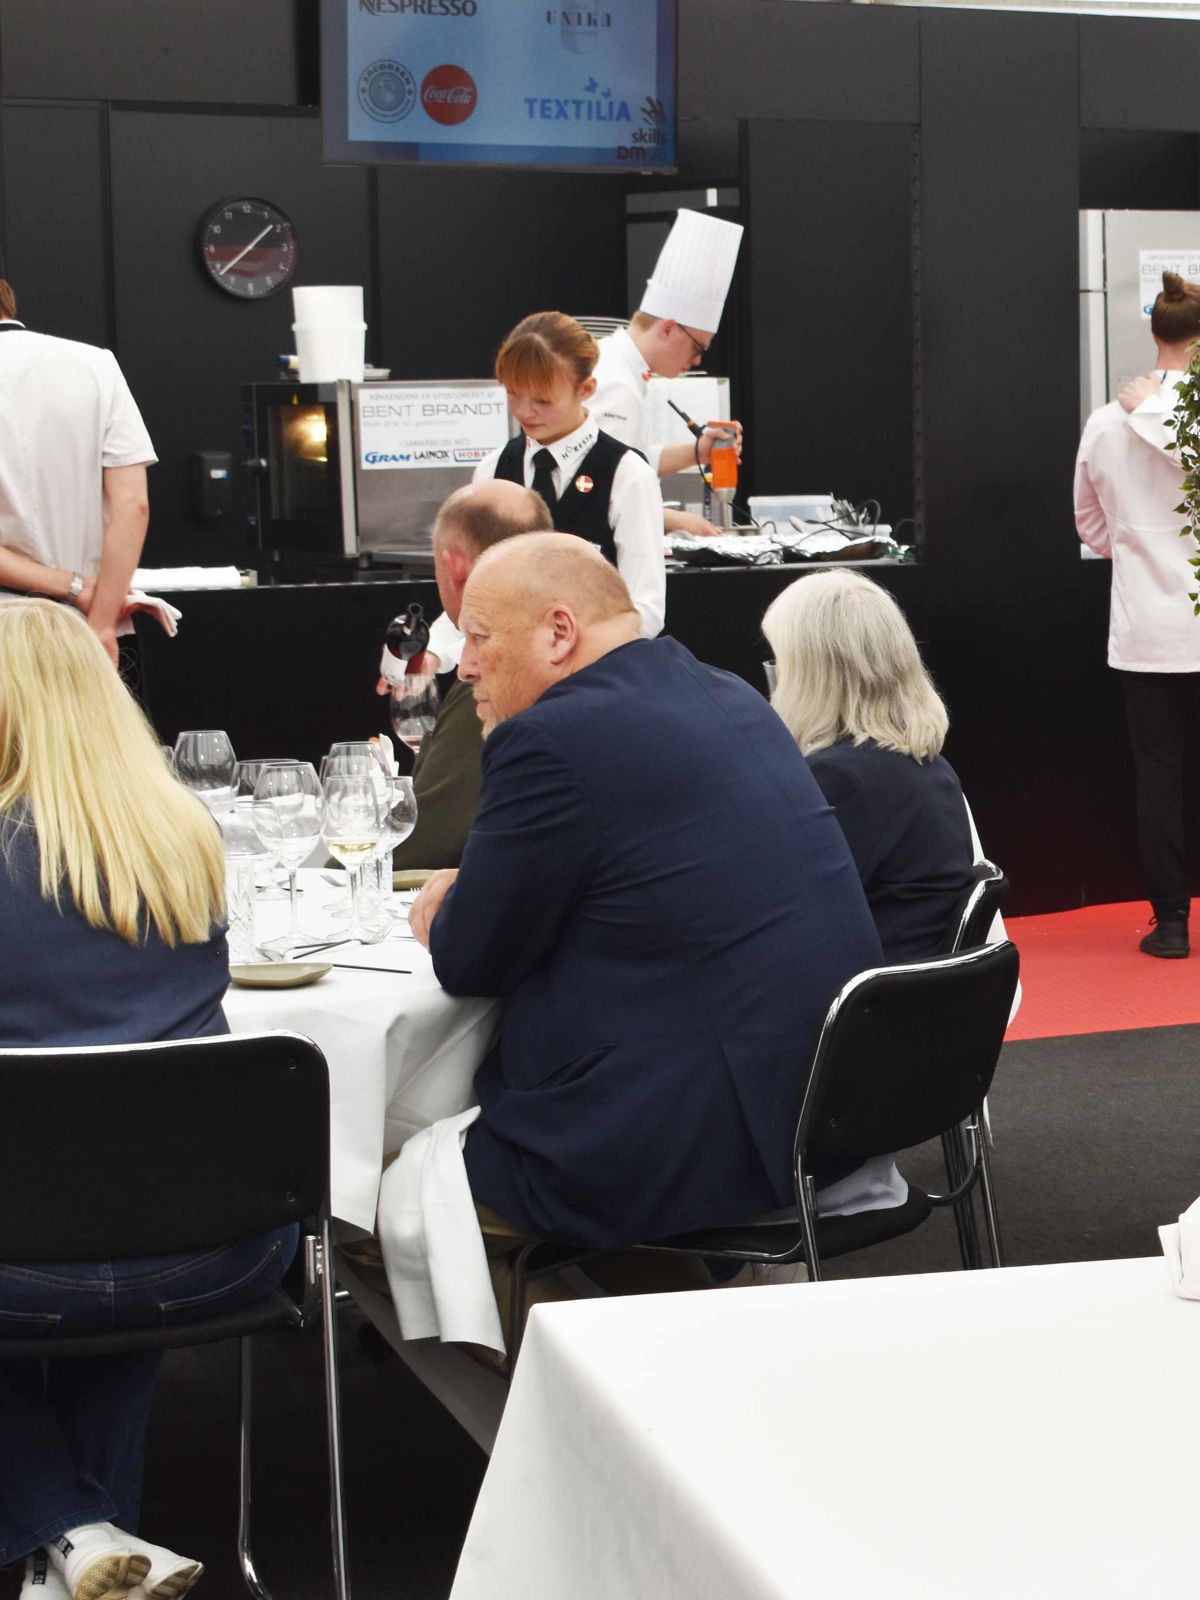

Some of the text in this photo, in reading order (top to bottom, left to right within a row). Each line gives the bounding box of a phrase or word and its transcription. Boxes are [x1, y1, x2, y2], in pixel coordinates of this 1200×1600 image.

[359, 0, 478, 17] NESPRESSO
[525, 97, 632, 122] TEXTILIA
[363, 403, 505, 418] BENT BRANDT
[364, 451, 411, 464] GRAM
[413, 450, 450, 460] LAINOX
